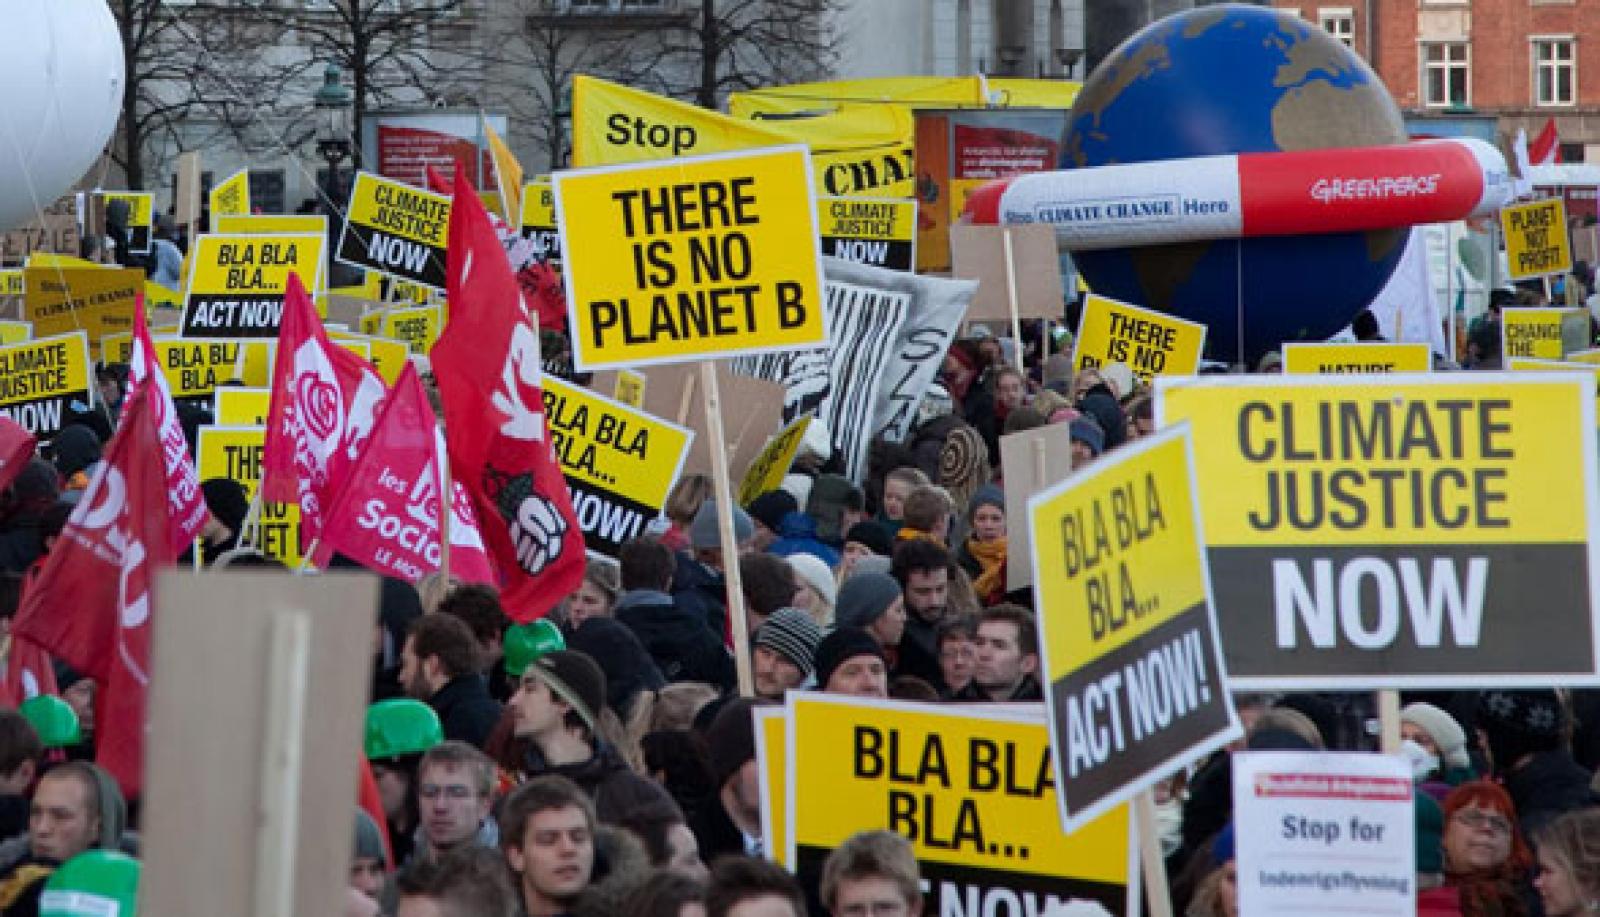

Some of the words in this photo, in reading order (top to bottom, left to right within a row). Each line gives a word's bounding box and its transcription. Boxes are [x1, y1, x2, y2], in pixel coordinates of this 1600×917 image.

[606, 113, 697, 155] Stop
[374, 183, 449, 223] CLIMATE
[612, 176, 760, 238] THERE
[1310, 173, 1441, 204] GREENPEACE
[370, 205, 444, 242] JUSTICE
[830, 202, 897, 218] CLIMATE
[831, 219, 894, 236] JUSTICE
[1038, 205, 1099, 223] CLIMATE
[1106, 199, 1174, 218] CHANGE
[1183, 199, 1230, 216] Here
[1509, 205, 1557, 232] PLANET
[217, 244, 254, 265] BLA
[261, 244, 297, 265] BLA
[368, 231, 431, 274] NOW
[835, 239, 888, 265] NOW
[1524, 228, 1549, 250] NOT
[226, 267, 279, 289] BLA...
[633, 241, 677, 291] IS
[689, 232, 752, 284] NO
[1518, 246, 1561, 273] PROFIT
[191, 301, 239, 328] ACT
[589, 283, 760, 349] PLANET
[776, 281, 808, 330] B
[1109, 312, 1177, 352] THERE
[168, 346, 203, 368] BLA
[1107, 337, 1130, 362] IS
[1134, 345, 1165, 373] NO
[1507, 340, 1536, 357] THE
[182, 368, 216, 390] BLA
[542, 389, 588, 435] BLA
[596, 413, 649, 460] BLA
[1237, 399, 1515, 461] CLIMATE
[1248, 468, 1511, 531] JUSTICE
[1061, 501, 1111, 577] BLA
[1111, 473, 1167, 552] BLA
[1086, 560, 1161, 643] BLA...
[1272, 556, 1490, 649] NOW
[1066, 677, 1130, 779] ACT
[1129, 626, 1212, 742] NOW!
[853, 725, 951, 789] BLA
[968, 737, 1055, 799] BLA
[887, 788, 1030, 860] BLA...
[1282, 815, 1341, 845] Stop
[1350, 815, 1385, 842] for
